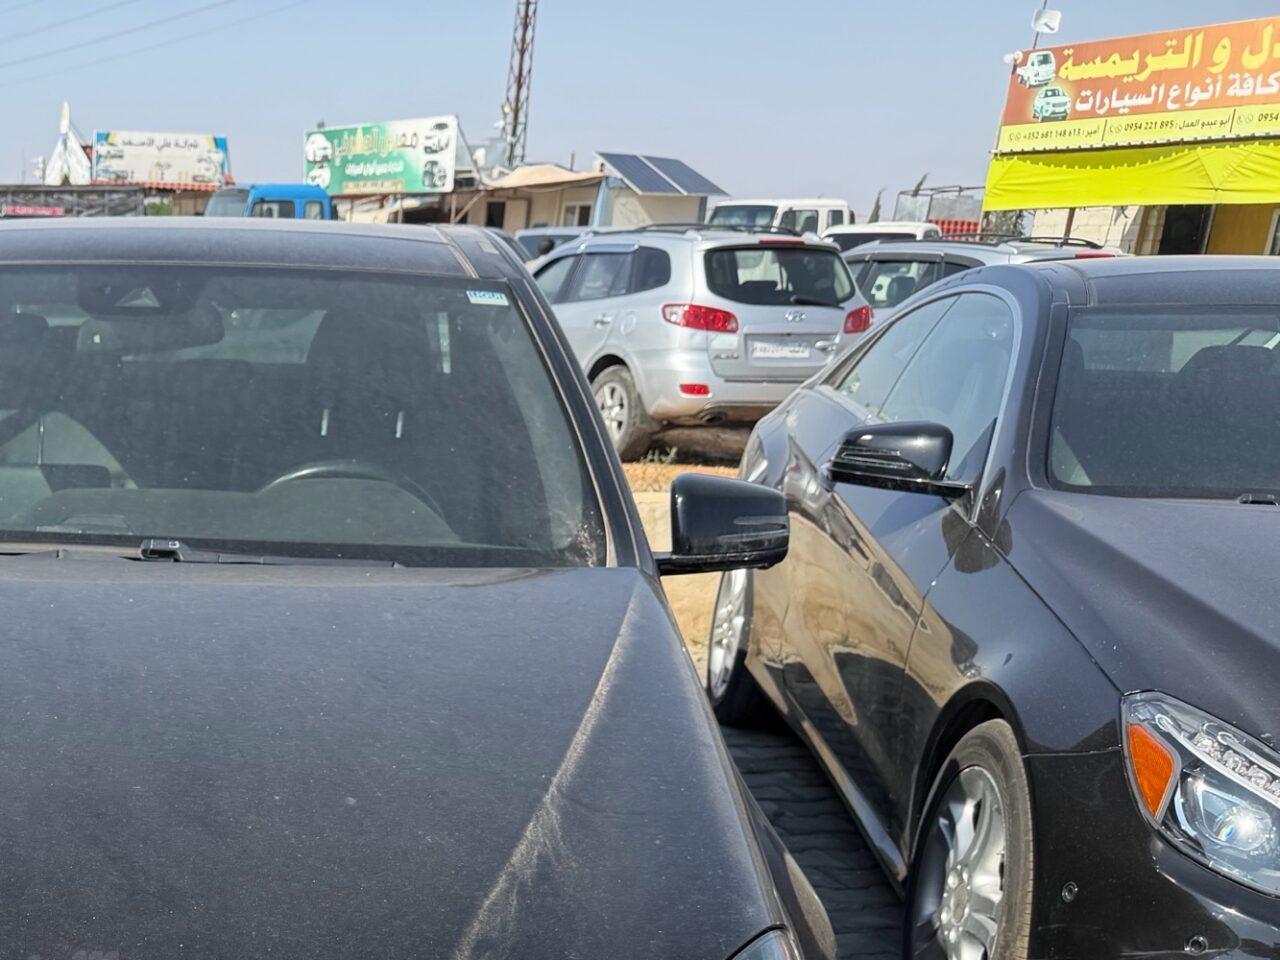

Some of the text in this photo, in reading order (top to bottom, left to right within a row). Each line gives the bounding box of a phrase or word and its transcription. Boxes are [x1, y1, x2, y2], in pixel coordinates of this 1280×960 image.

[1206, 36, 1232, 74] و
[1075, 82, 1165, 115] السيارات
[1124, 122, 1143, 132] 0954
[1144, 121, 1157, 130] 221
[1159, 120, 1174, 129] 895
